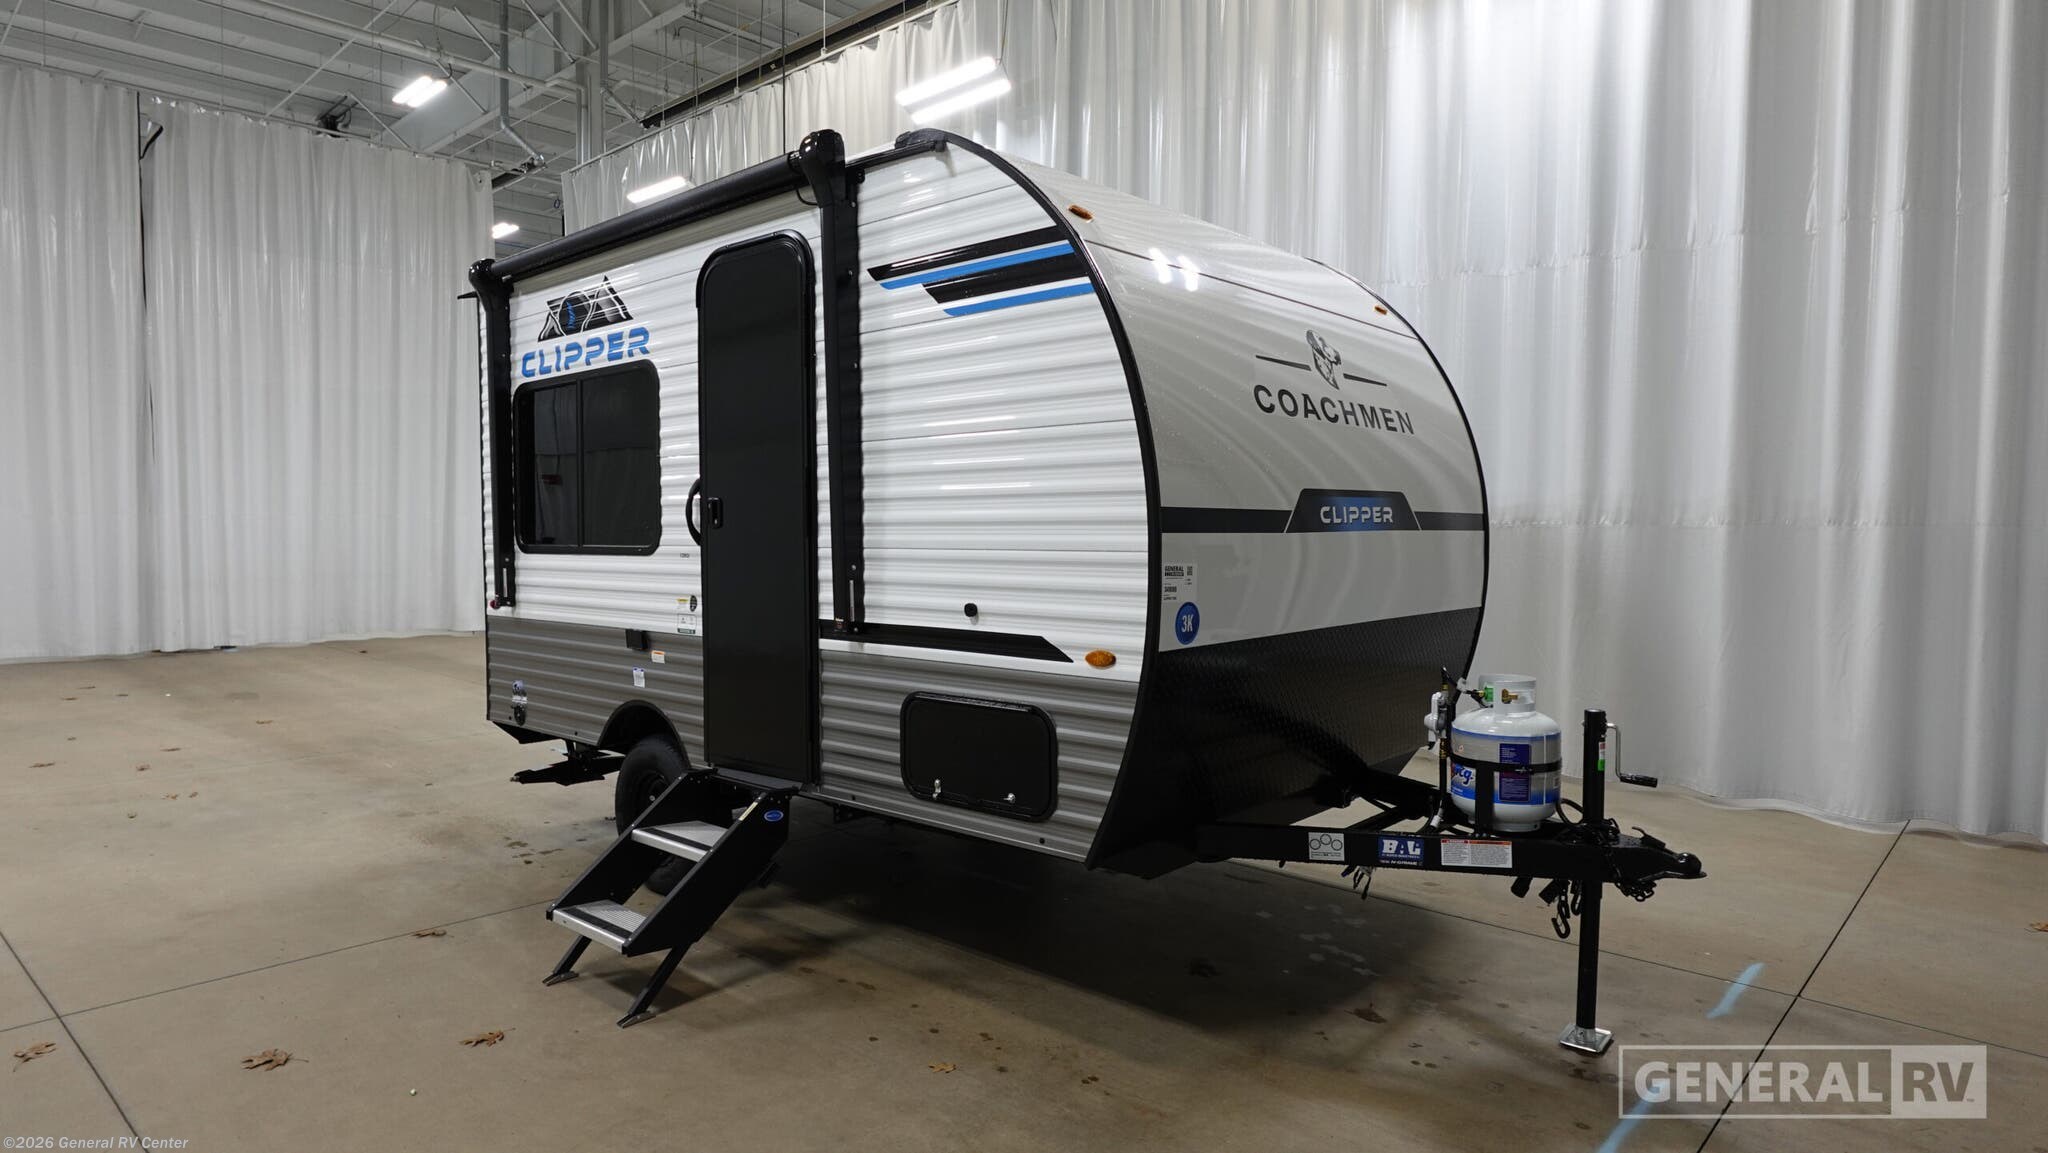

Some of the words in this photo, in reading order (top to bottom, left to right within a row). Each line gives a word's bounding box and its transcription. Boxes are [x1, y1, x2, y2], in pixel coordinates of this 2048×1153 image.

[521, 326, 651, 379] CLIPPER
[1253, 384, 1415, 435] COACHMEN
[1319, 505, 1395, 525] CLIPPER
[1181, 614, 1194, 633] 3K
[1382, 839, 1422, 856] BAL
